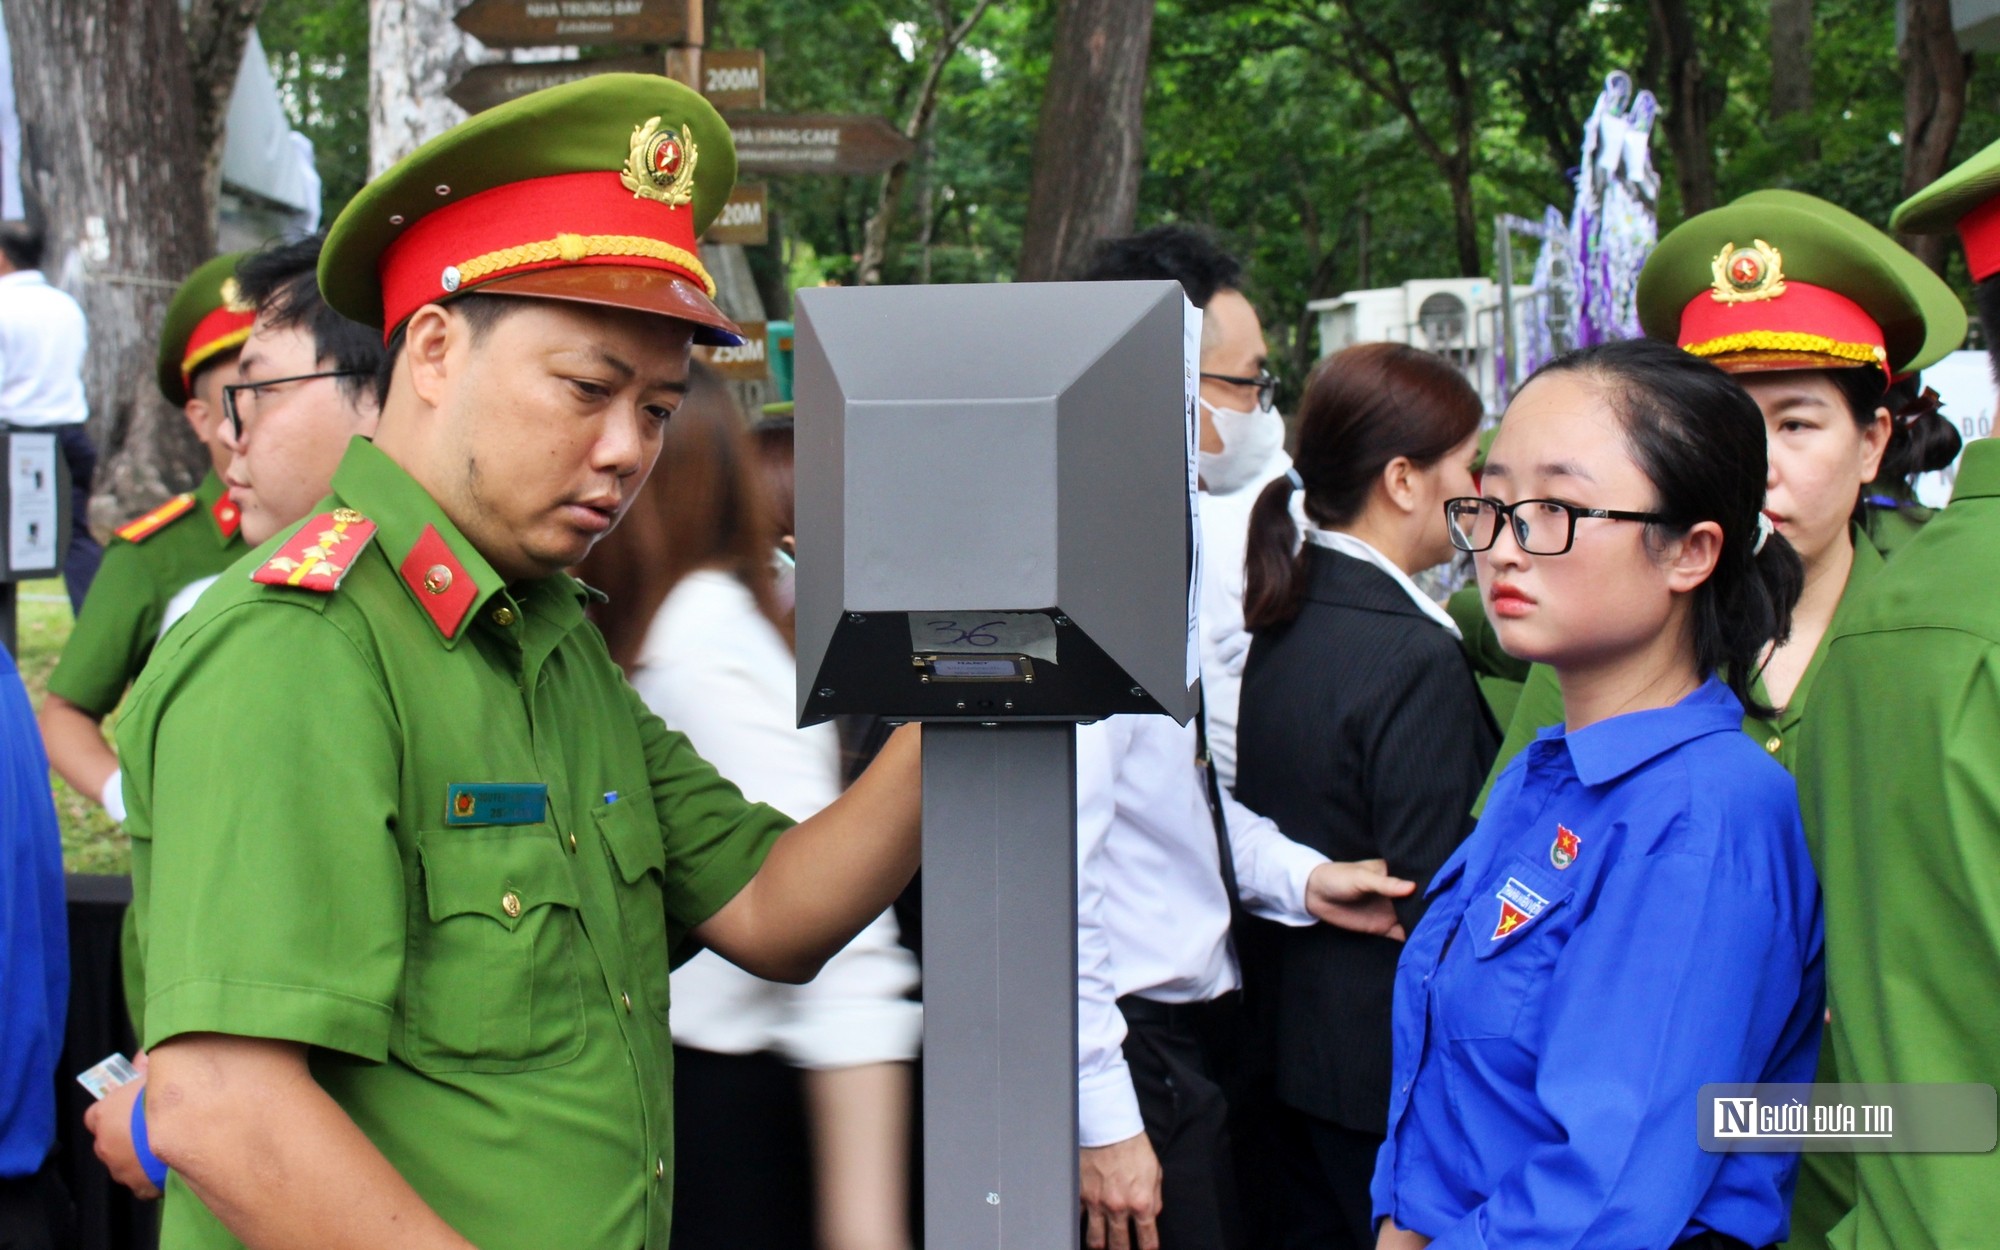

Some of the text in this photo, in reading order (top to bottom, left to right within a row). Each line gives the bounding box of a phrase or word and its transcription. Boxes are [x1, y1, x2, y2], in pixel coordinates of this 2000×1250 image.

[706, 67, 759, 91] 200M
[713, 202, 762, 226] 20M
[927, 620, 1007, 647] 36
